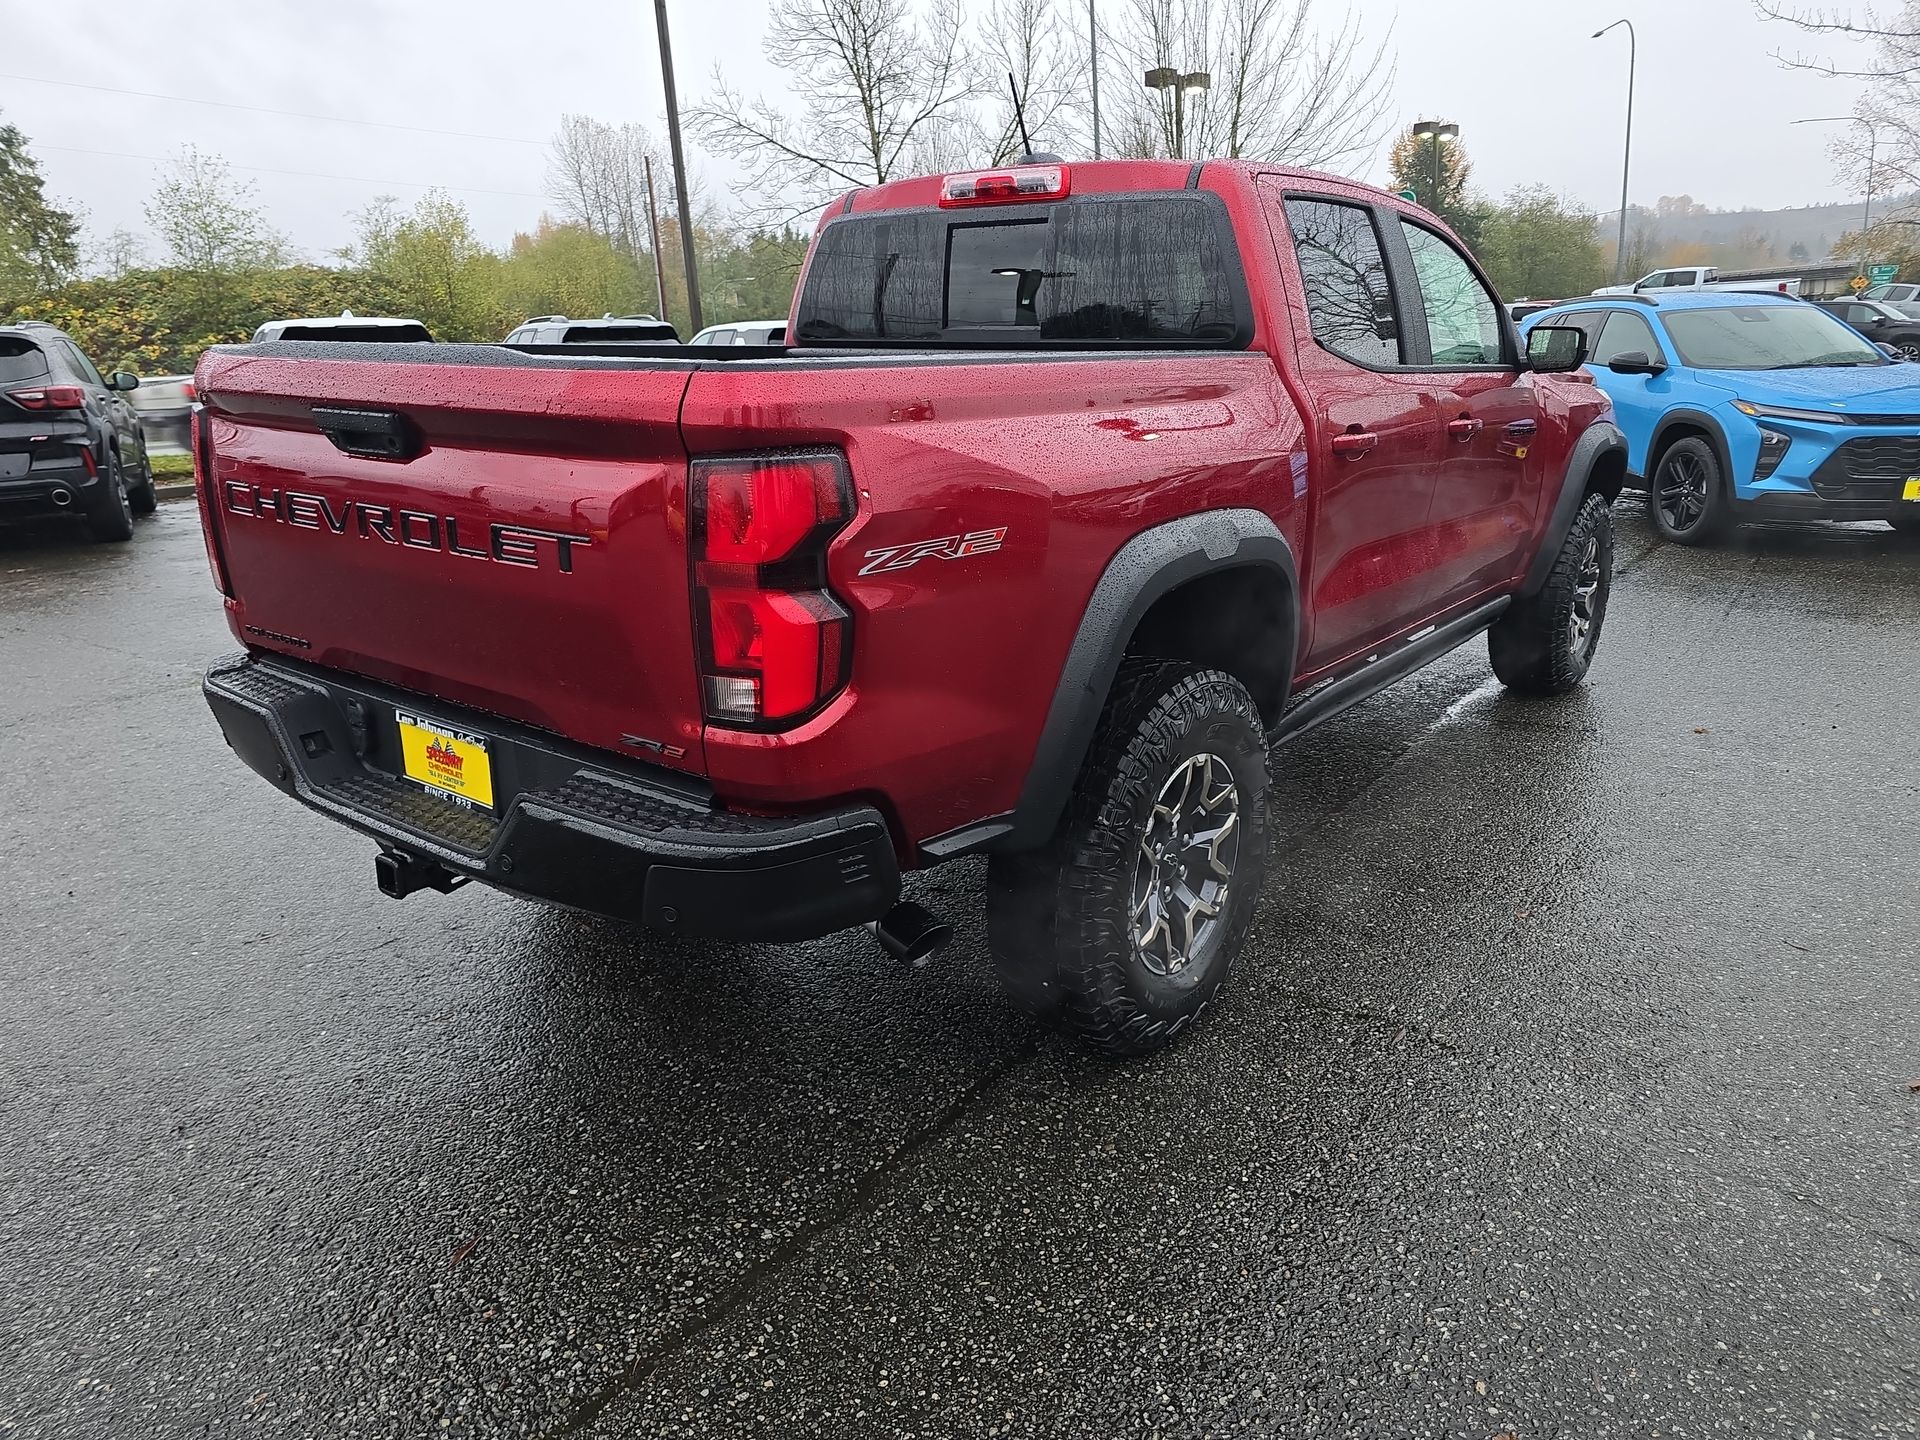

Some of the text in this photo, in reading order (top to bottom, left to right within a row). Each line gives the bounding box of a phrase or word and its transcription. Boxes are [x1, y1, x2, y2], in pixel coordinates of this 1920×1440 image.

[225, 480, 592, 575] CHEVROLET
[858, 526, 1009, 576] ZR2
[417, 716, 454, 739] Johnson
[618, 731, 687, 760] ZR2
[428, 761, 463, 779] CHEVROLET
[424, 786, 449, 801] SINCE
